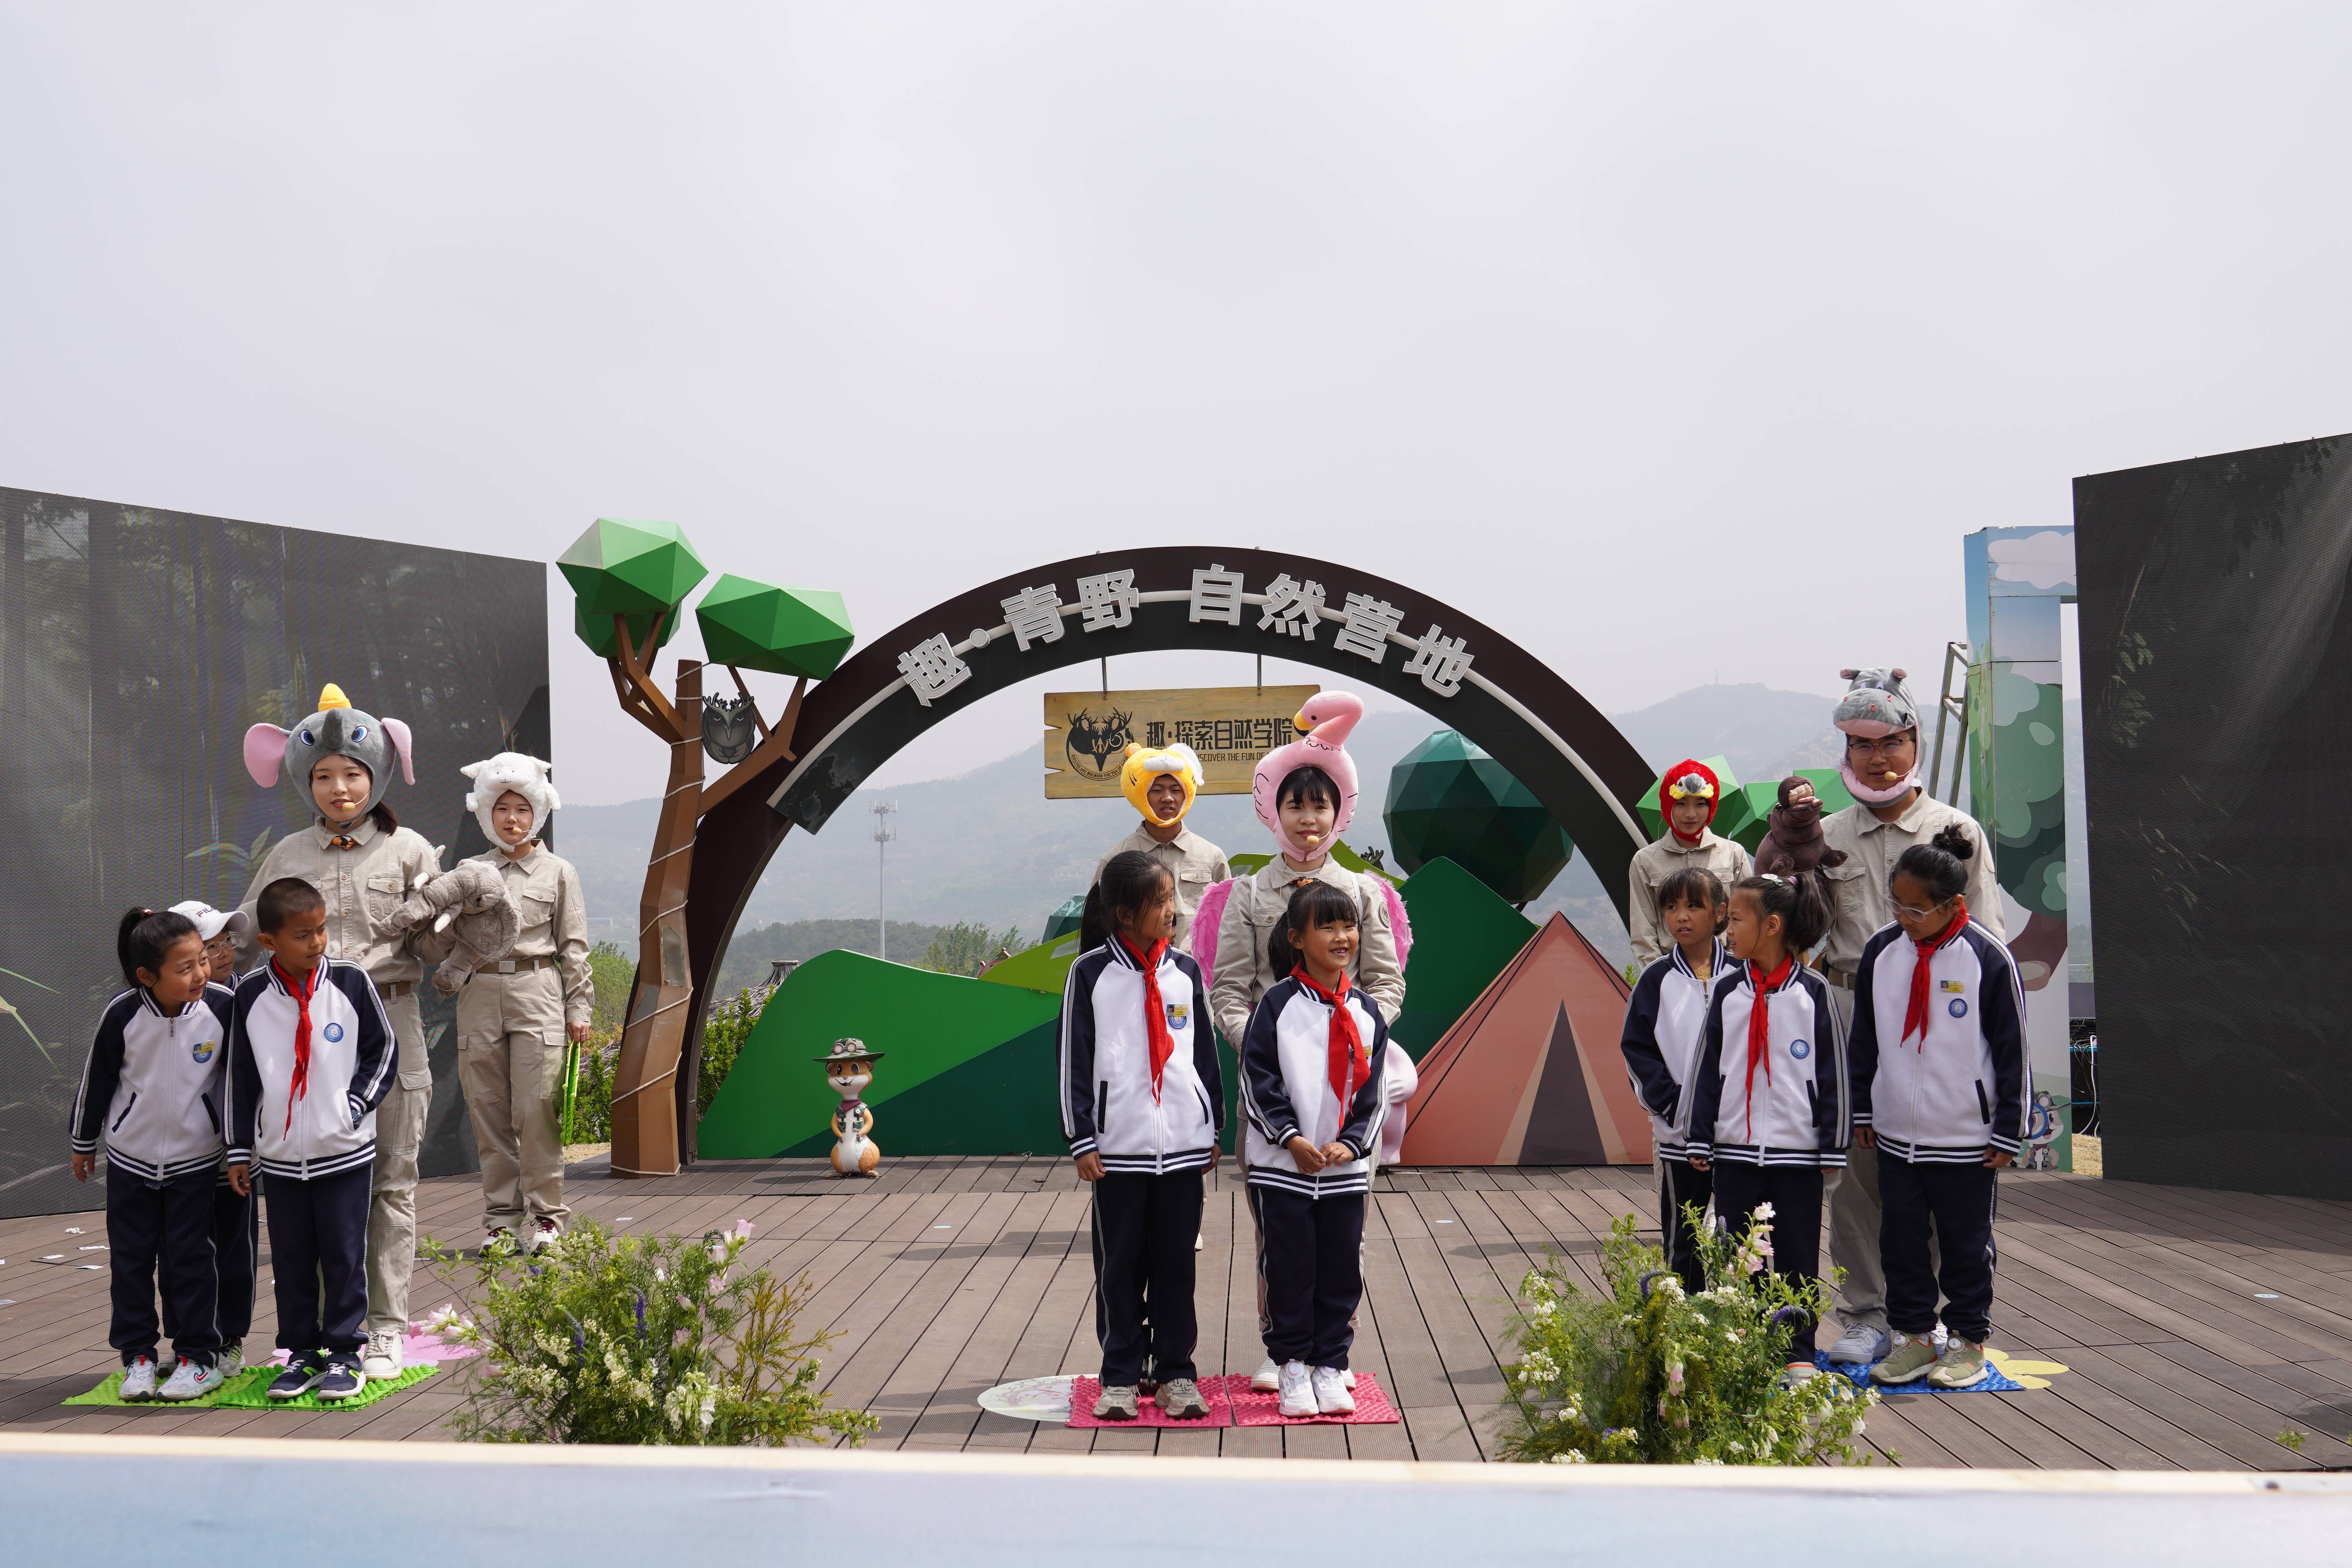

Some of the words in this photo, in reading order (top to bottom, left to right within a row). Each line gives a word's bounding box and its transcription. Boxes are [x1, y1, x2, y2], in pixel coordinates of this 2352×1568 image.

[1196, 753, 1225, 762] ISCOVER
[1227, 753, 1240, 761] THE
[1241, 752, 1255, 761] FUN
